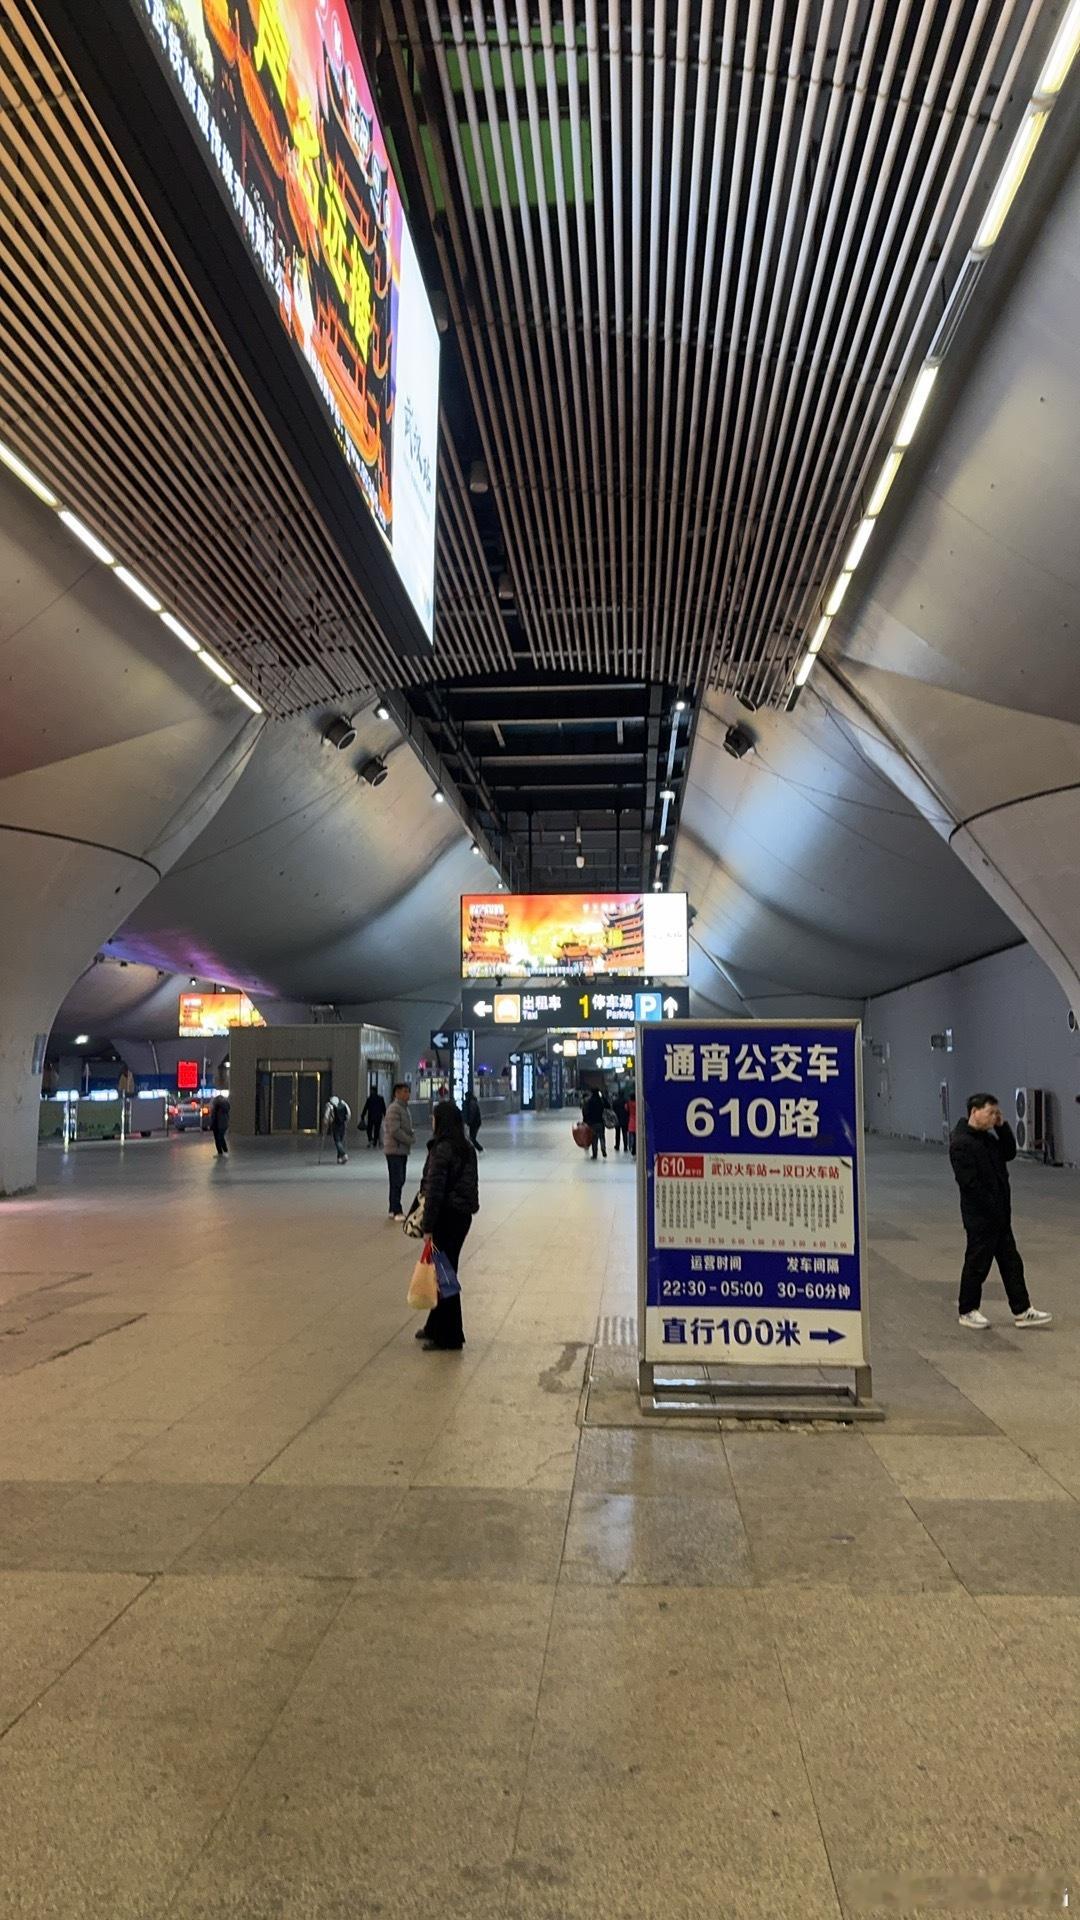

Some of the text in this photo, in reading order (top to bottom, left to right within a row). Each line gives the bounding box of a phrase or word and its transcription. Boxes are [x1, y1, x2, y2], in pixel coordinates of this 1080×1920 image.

[523, 994, 562, 1011] 出租车
[579, 994, 633, 1019] 1 停车场
[522, 1010, 538, 1020] Taxi
[606, 1010, 635, 1021] Parking
[664, 1043, 839, 1083] 通宵公交车
[686, 1097, 820, 1138] 610路
[661, 1157, 686, 1176] 610
[711, 1162, 768, 1177] 武汉火车站
[782, 1164, 840, 1180] 汉口火车站
[691, 1255, 742, 1271] 运营时间
[787, 1256, 840, 1274] 发车间隔
[777, 1282, 851, 1300] 30-60分钟
[662, 1317, 801, 1347] 直行100米
